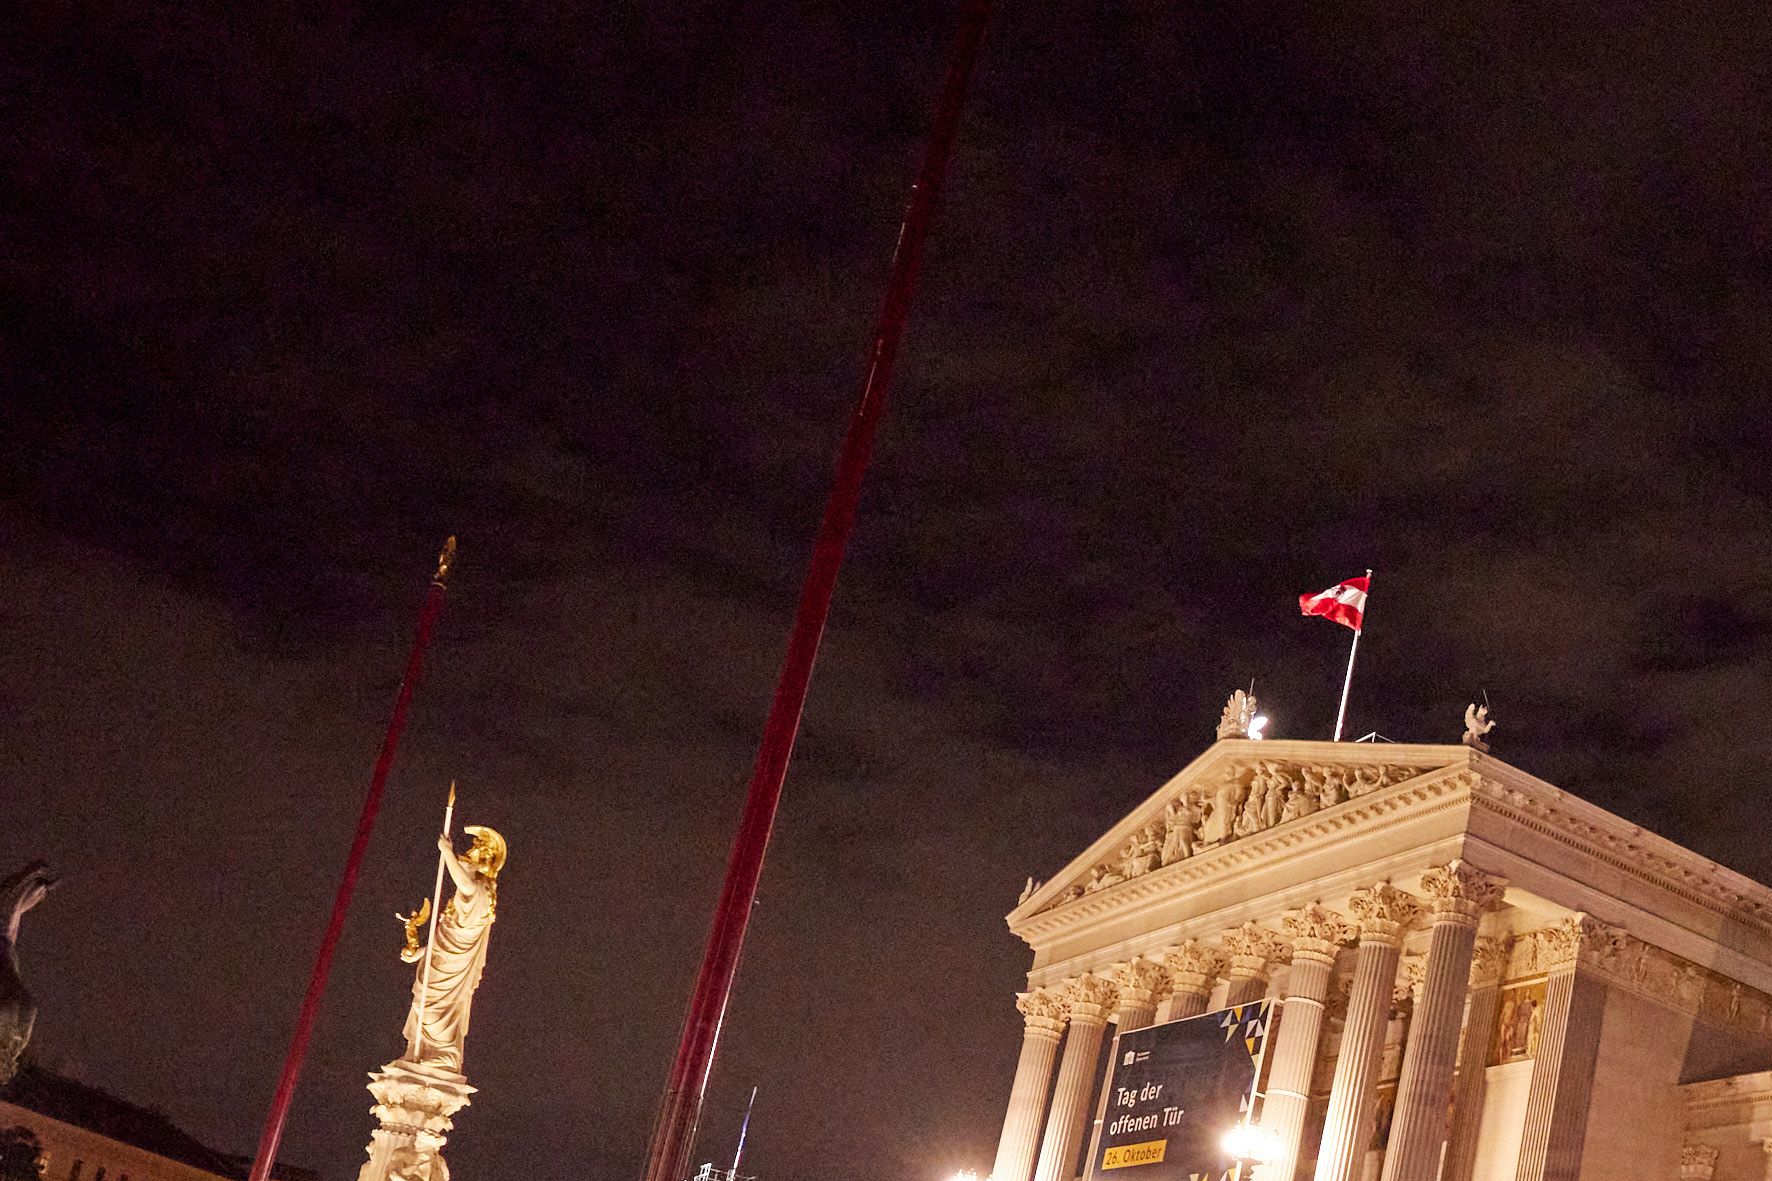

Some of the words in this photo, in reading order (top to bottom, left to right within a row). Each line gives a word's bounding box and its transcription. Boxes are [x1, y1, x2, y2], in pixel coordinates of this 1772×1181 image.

[1117, 1087, 1137, 1107] Tag
[1140, 1082, 1163, 1101] der
[1109, 1114, 1158, 1136] offenen
[1163, 1106, 1184, 1126] Tür
[1106, 1152, 1120, 1165] 26.
[1123, 1146, 1162, 1163] Oktober
